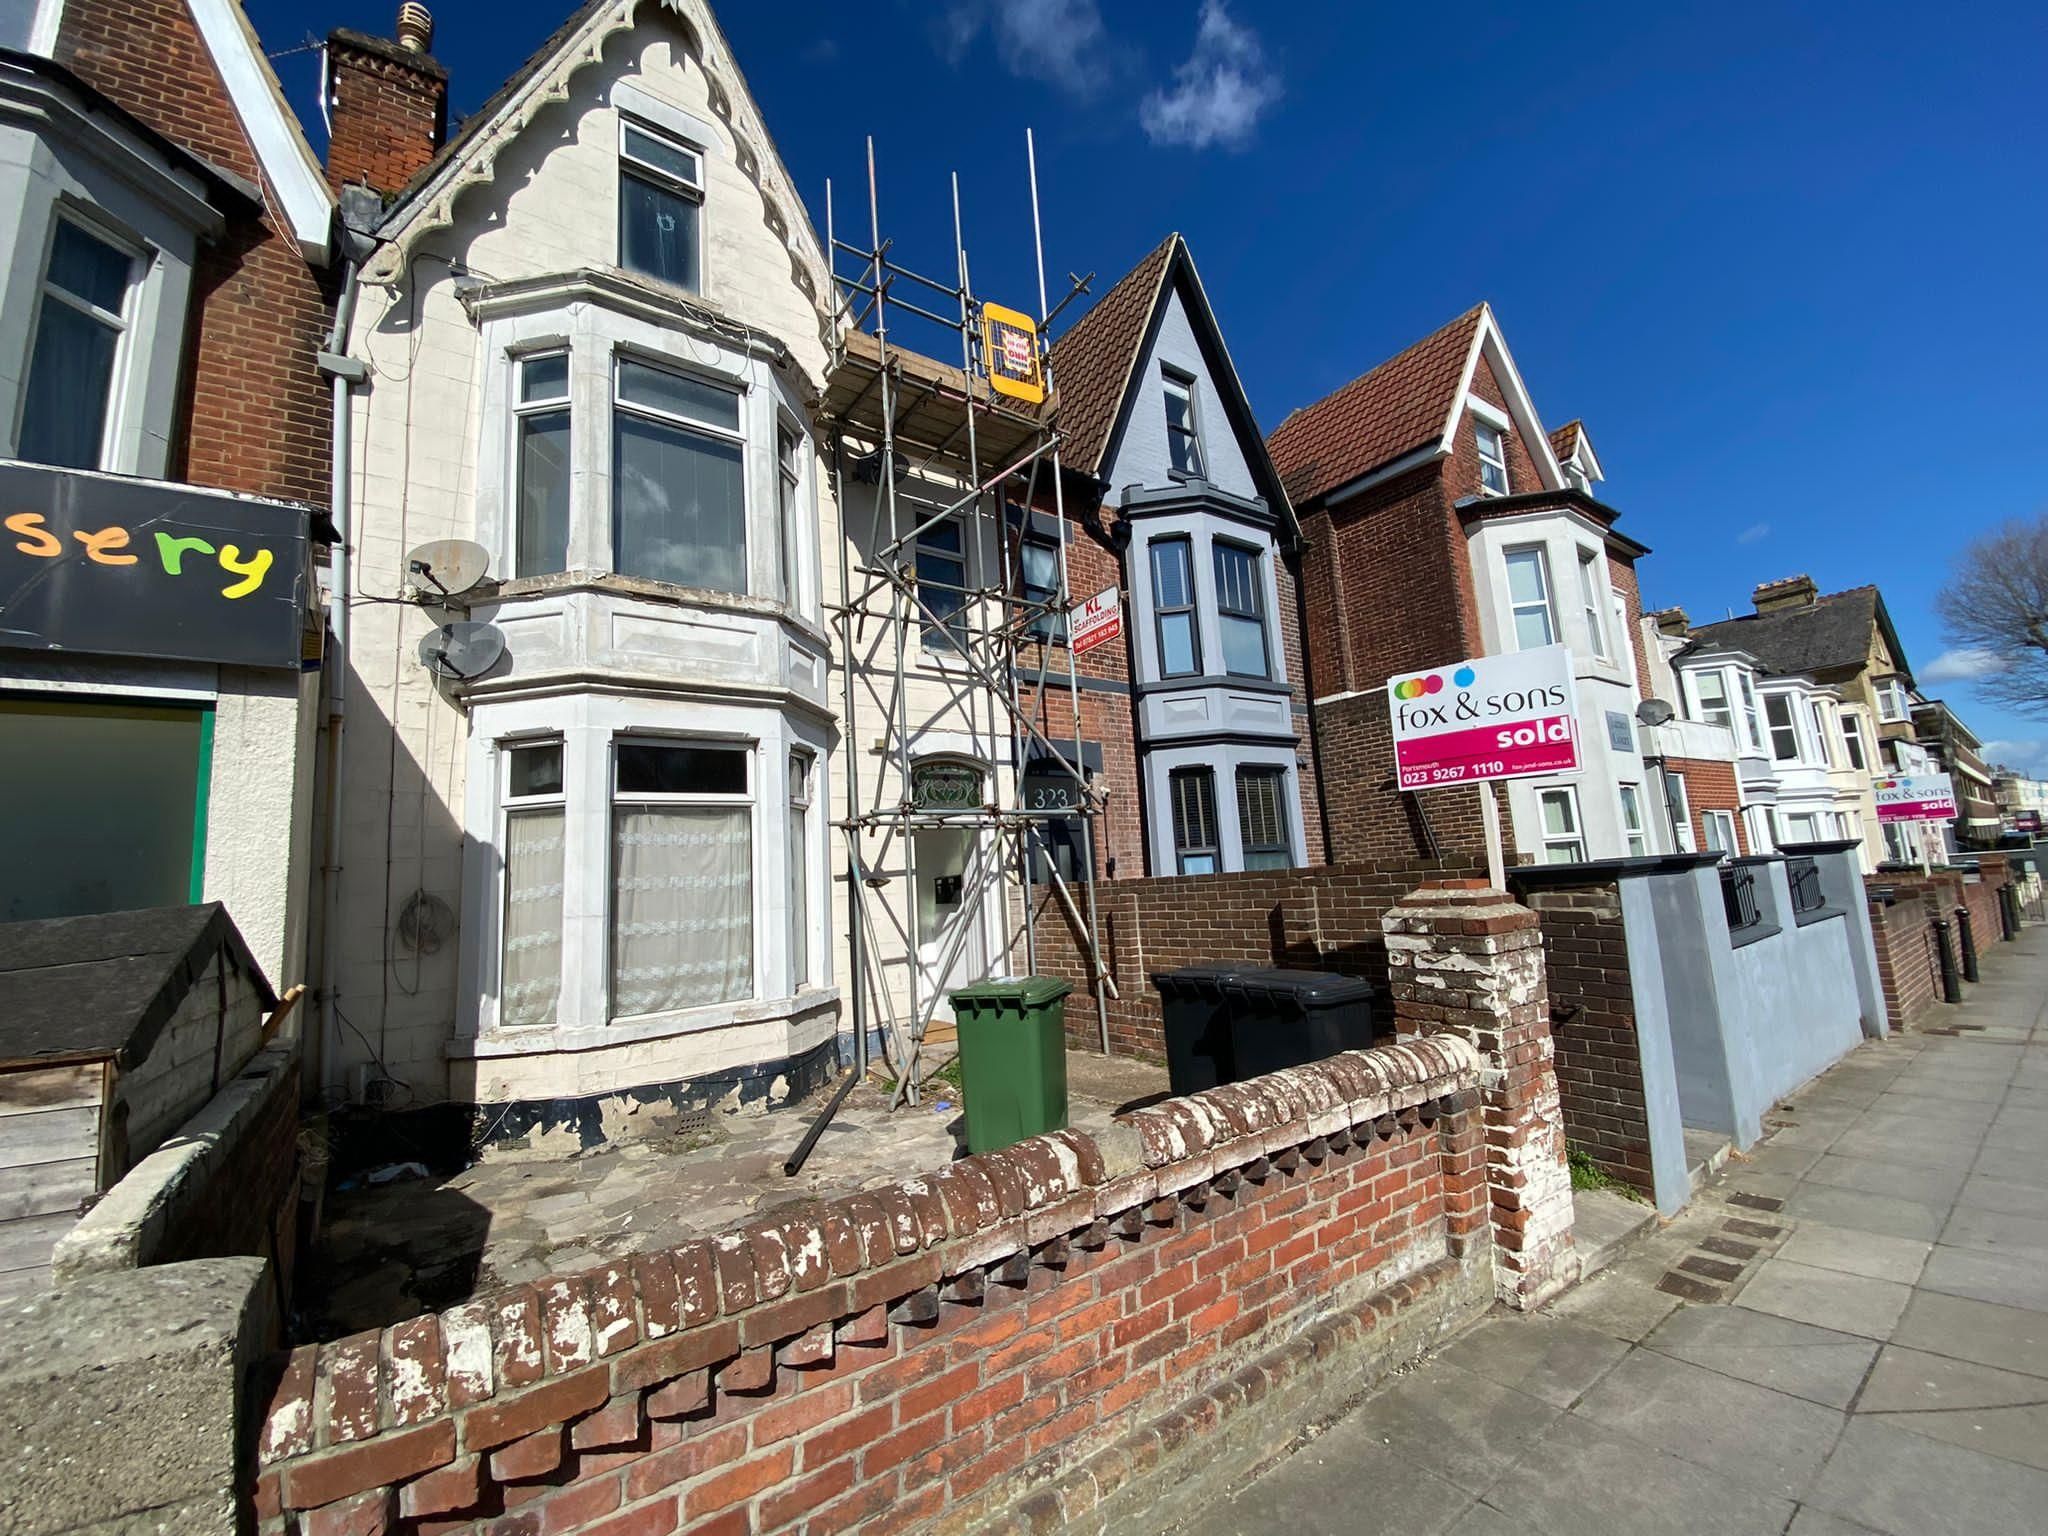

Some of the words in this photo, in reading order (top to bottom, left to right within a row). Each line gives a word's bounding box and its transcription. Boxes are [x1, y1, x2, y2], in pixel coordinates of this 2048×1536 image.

[4, 512, 274, 600] sery
[1085, 597, 1102, 617] KL
[1074, 605, 1117, 633] SCAFFOLDING
[1397, 703, 1448, 731] fox
[1455, 691, 1481, 721] &
[1487, 684, 1566, 716] sons
[1496, 717, 1571, 749] sold
[1402, 762, 1440, 772] Portsmouth
[1403, 772, 1428, 785] 023
[1433, 766, 1465, 781] 9267
[1472, 761, 1504, 775] 1110
[1034, 788, 1069, 809] 323
[1876, 791, 1900, 802] fox
[1903, 788, 1914, 799] &
[1917, 787, 1951, 799] sons
[1921, 799, 1953, 810] sold
